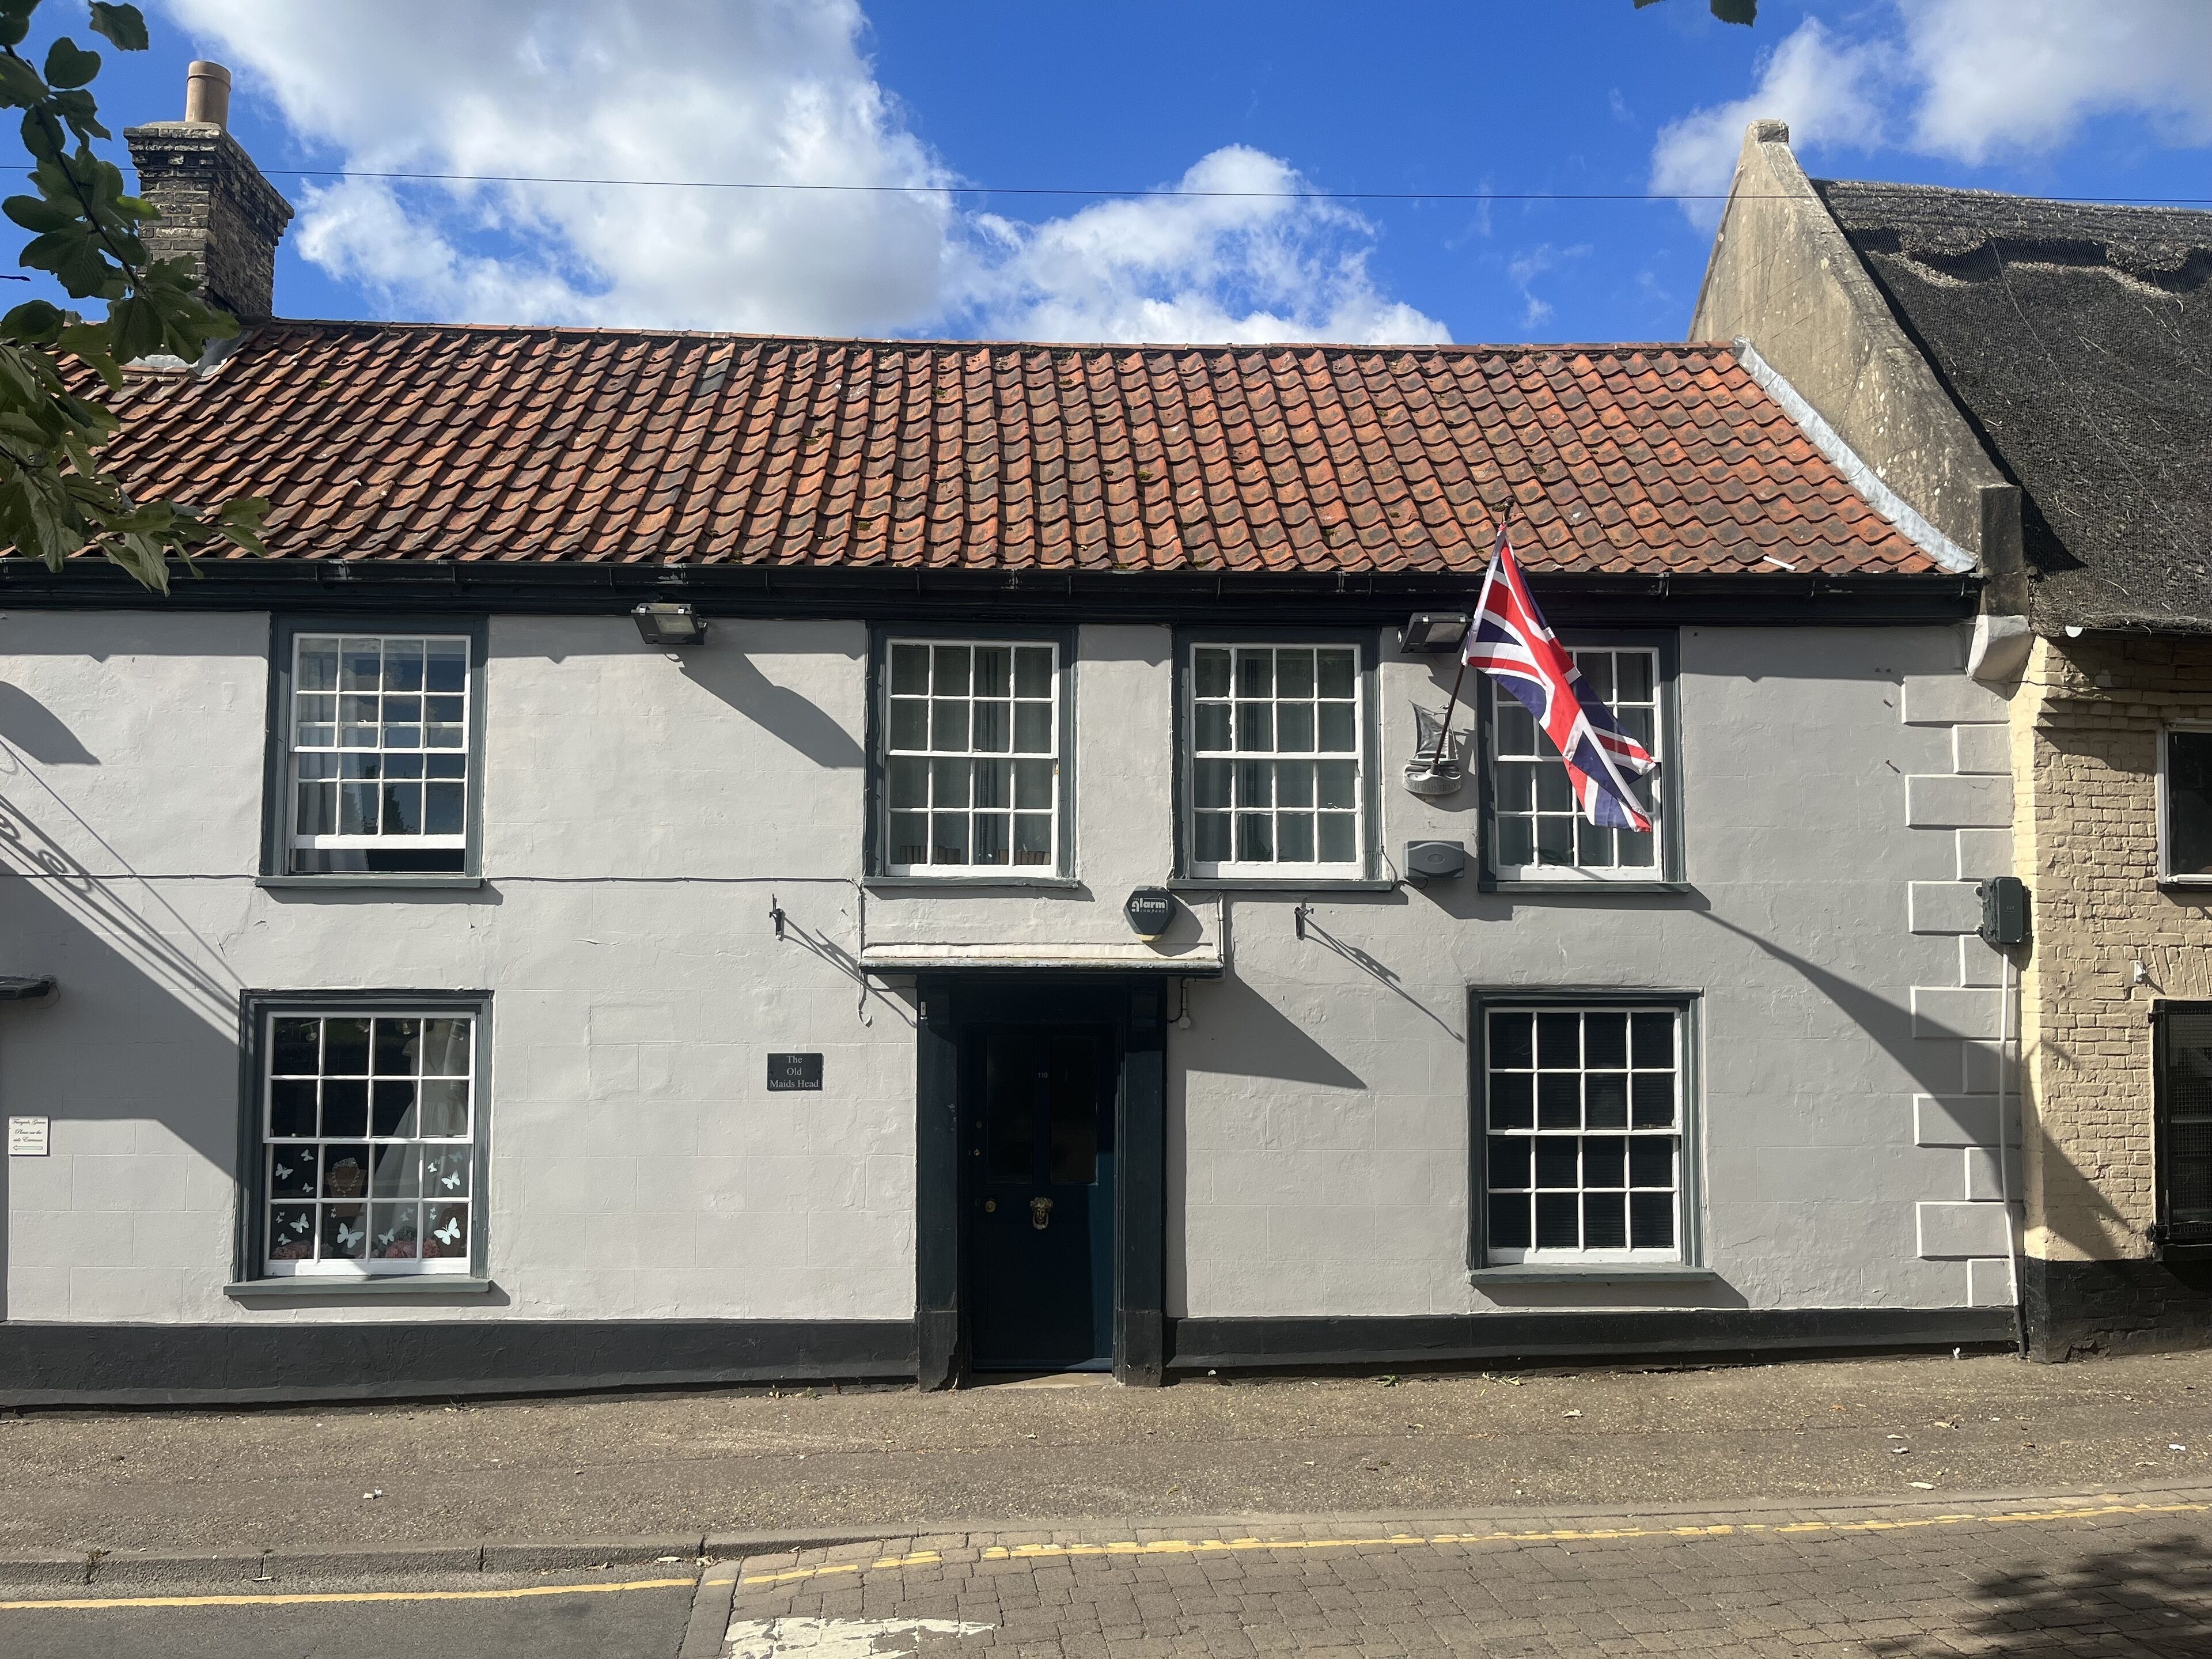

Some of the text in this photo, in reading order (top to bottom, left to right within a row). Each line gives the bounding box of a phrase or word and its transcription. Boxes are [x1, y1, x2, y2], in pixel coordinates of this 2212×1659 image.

[1131, 897, 1165, 912] alarm
[786, 1055, 802, 1063] The
[787, 1067, 802, 1075] Old
[770, 1080, 819, 1088] Maids Head
